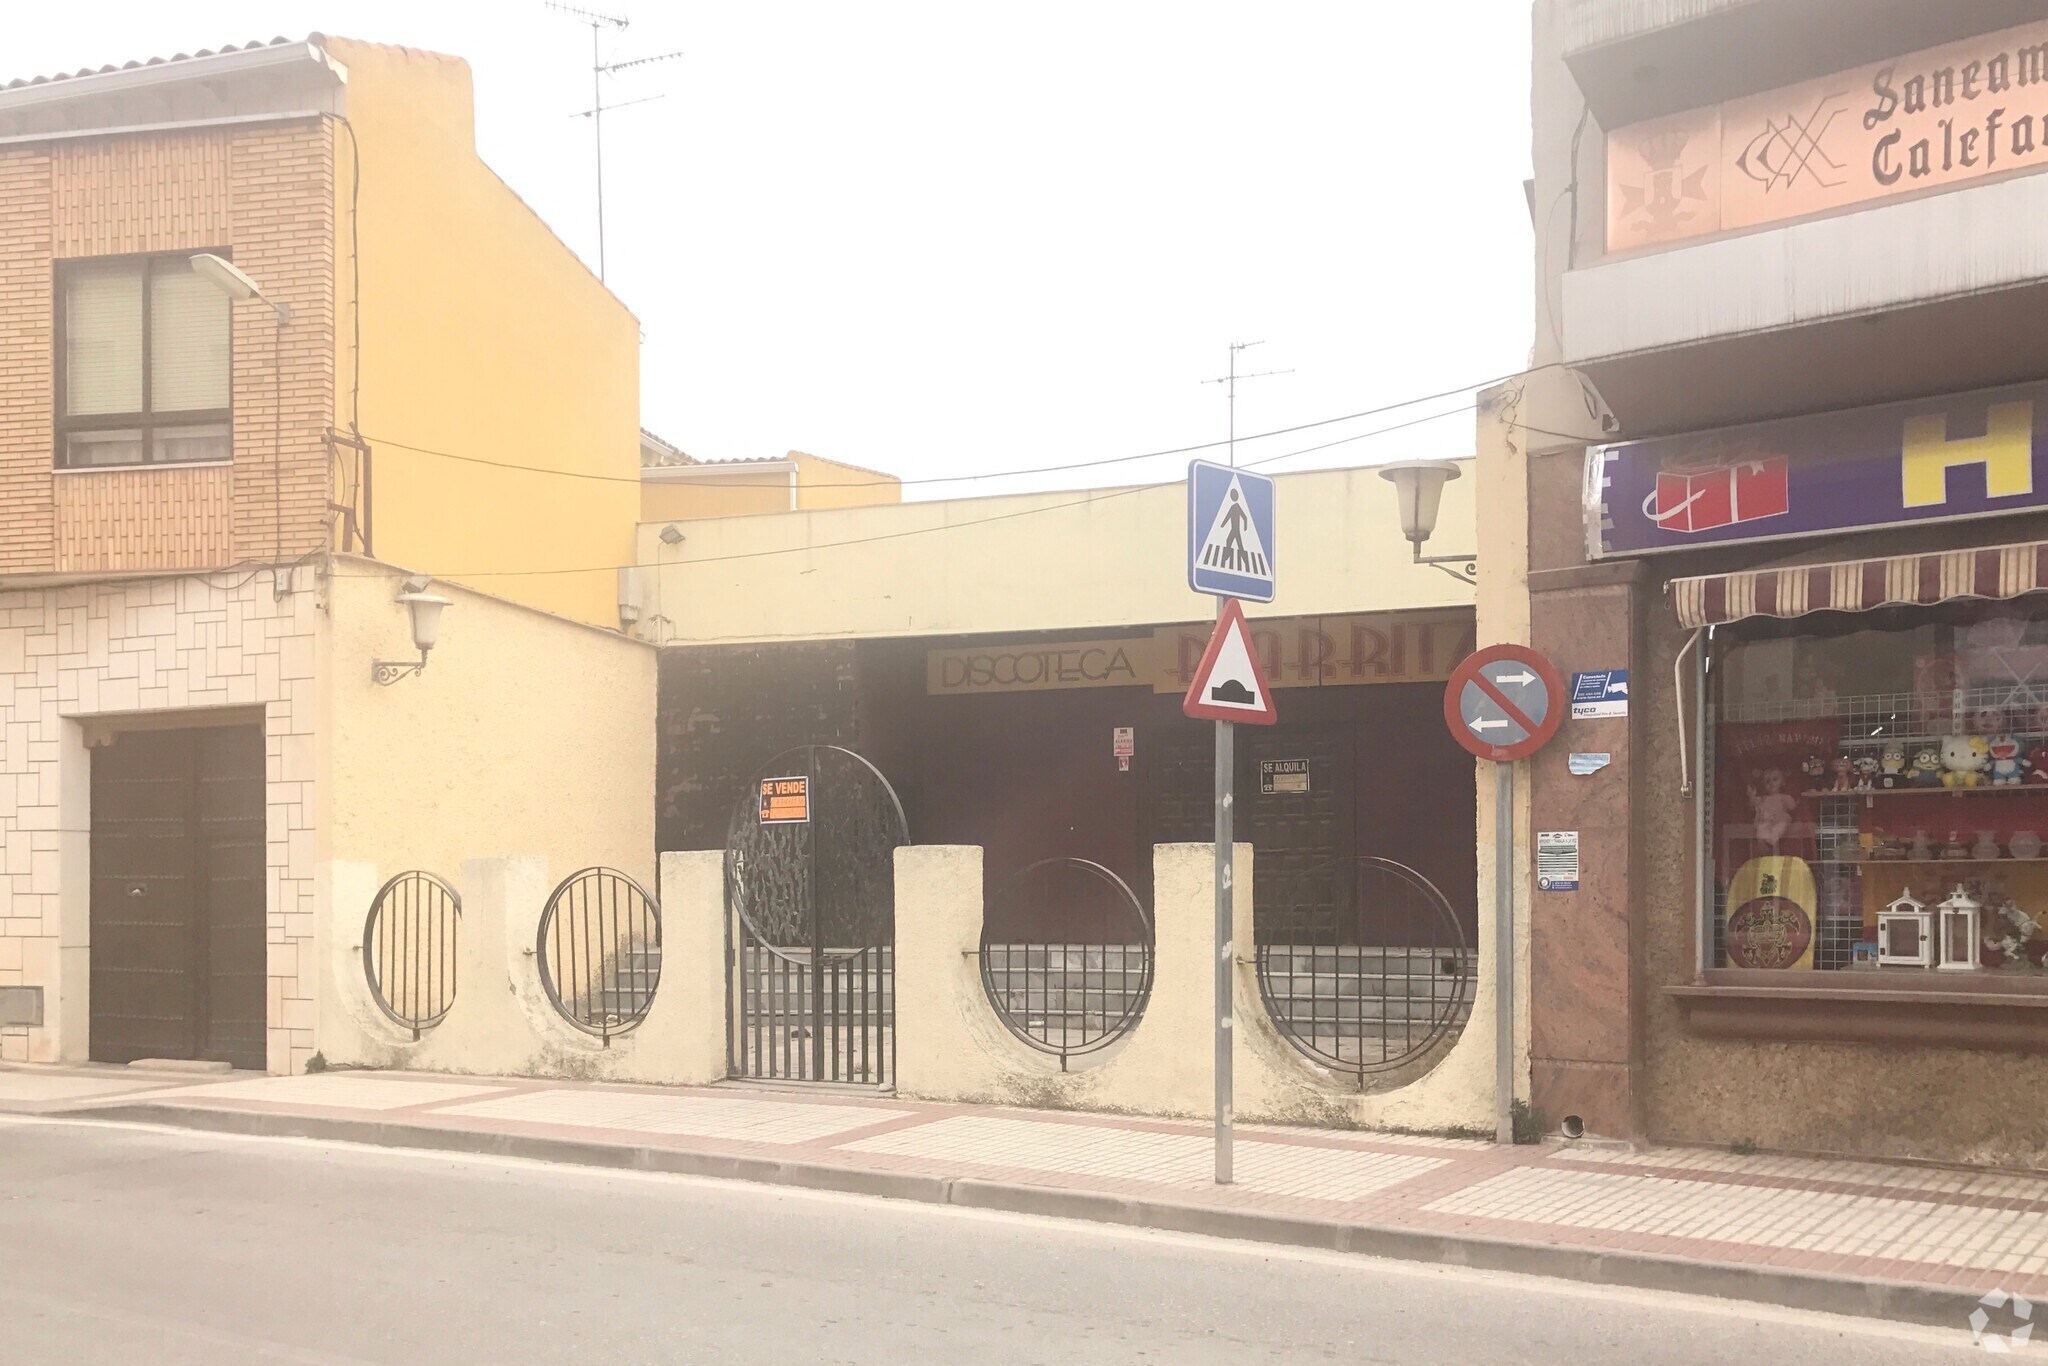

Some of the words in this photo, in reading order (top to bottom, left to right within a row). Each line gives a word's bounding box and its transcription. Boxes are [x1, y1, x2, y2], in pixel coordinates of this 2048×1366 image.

[1873, 107, 2048, 185] Calefa
[1902, 400, 2033, 508] H
[942, 647, 1136, 688] DISCOTECA
[1573, 707, 1596, 715] tyco
[1263, 763, 1273, 773] SE
[1275, 761, 1307, 773] ALQUILA
[762, 783, 773, 795] SE
[775, 781, 805, 794] VENDE
